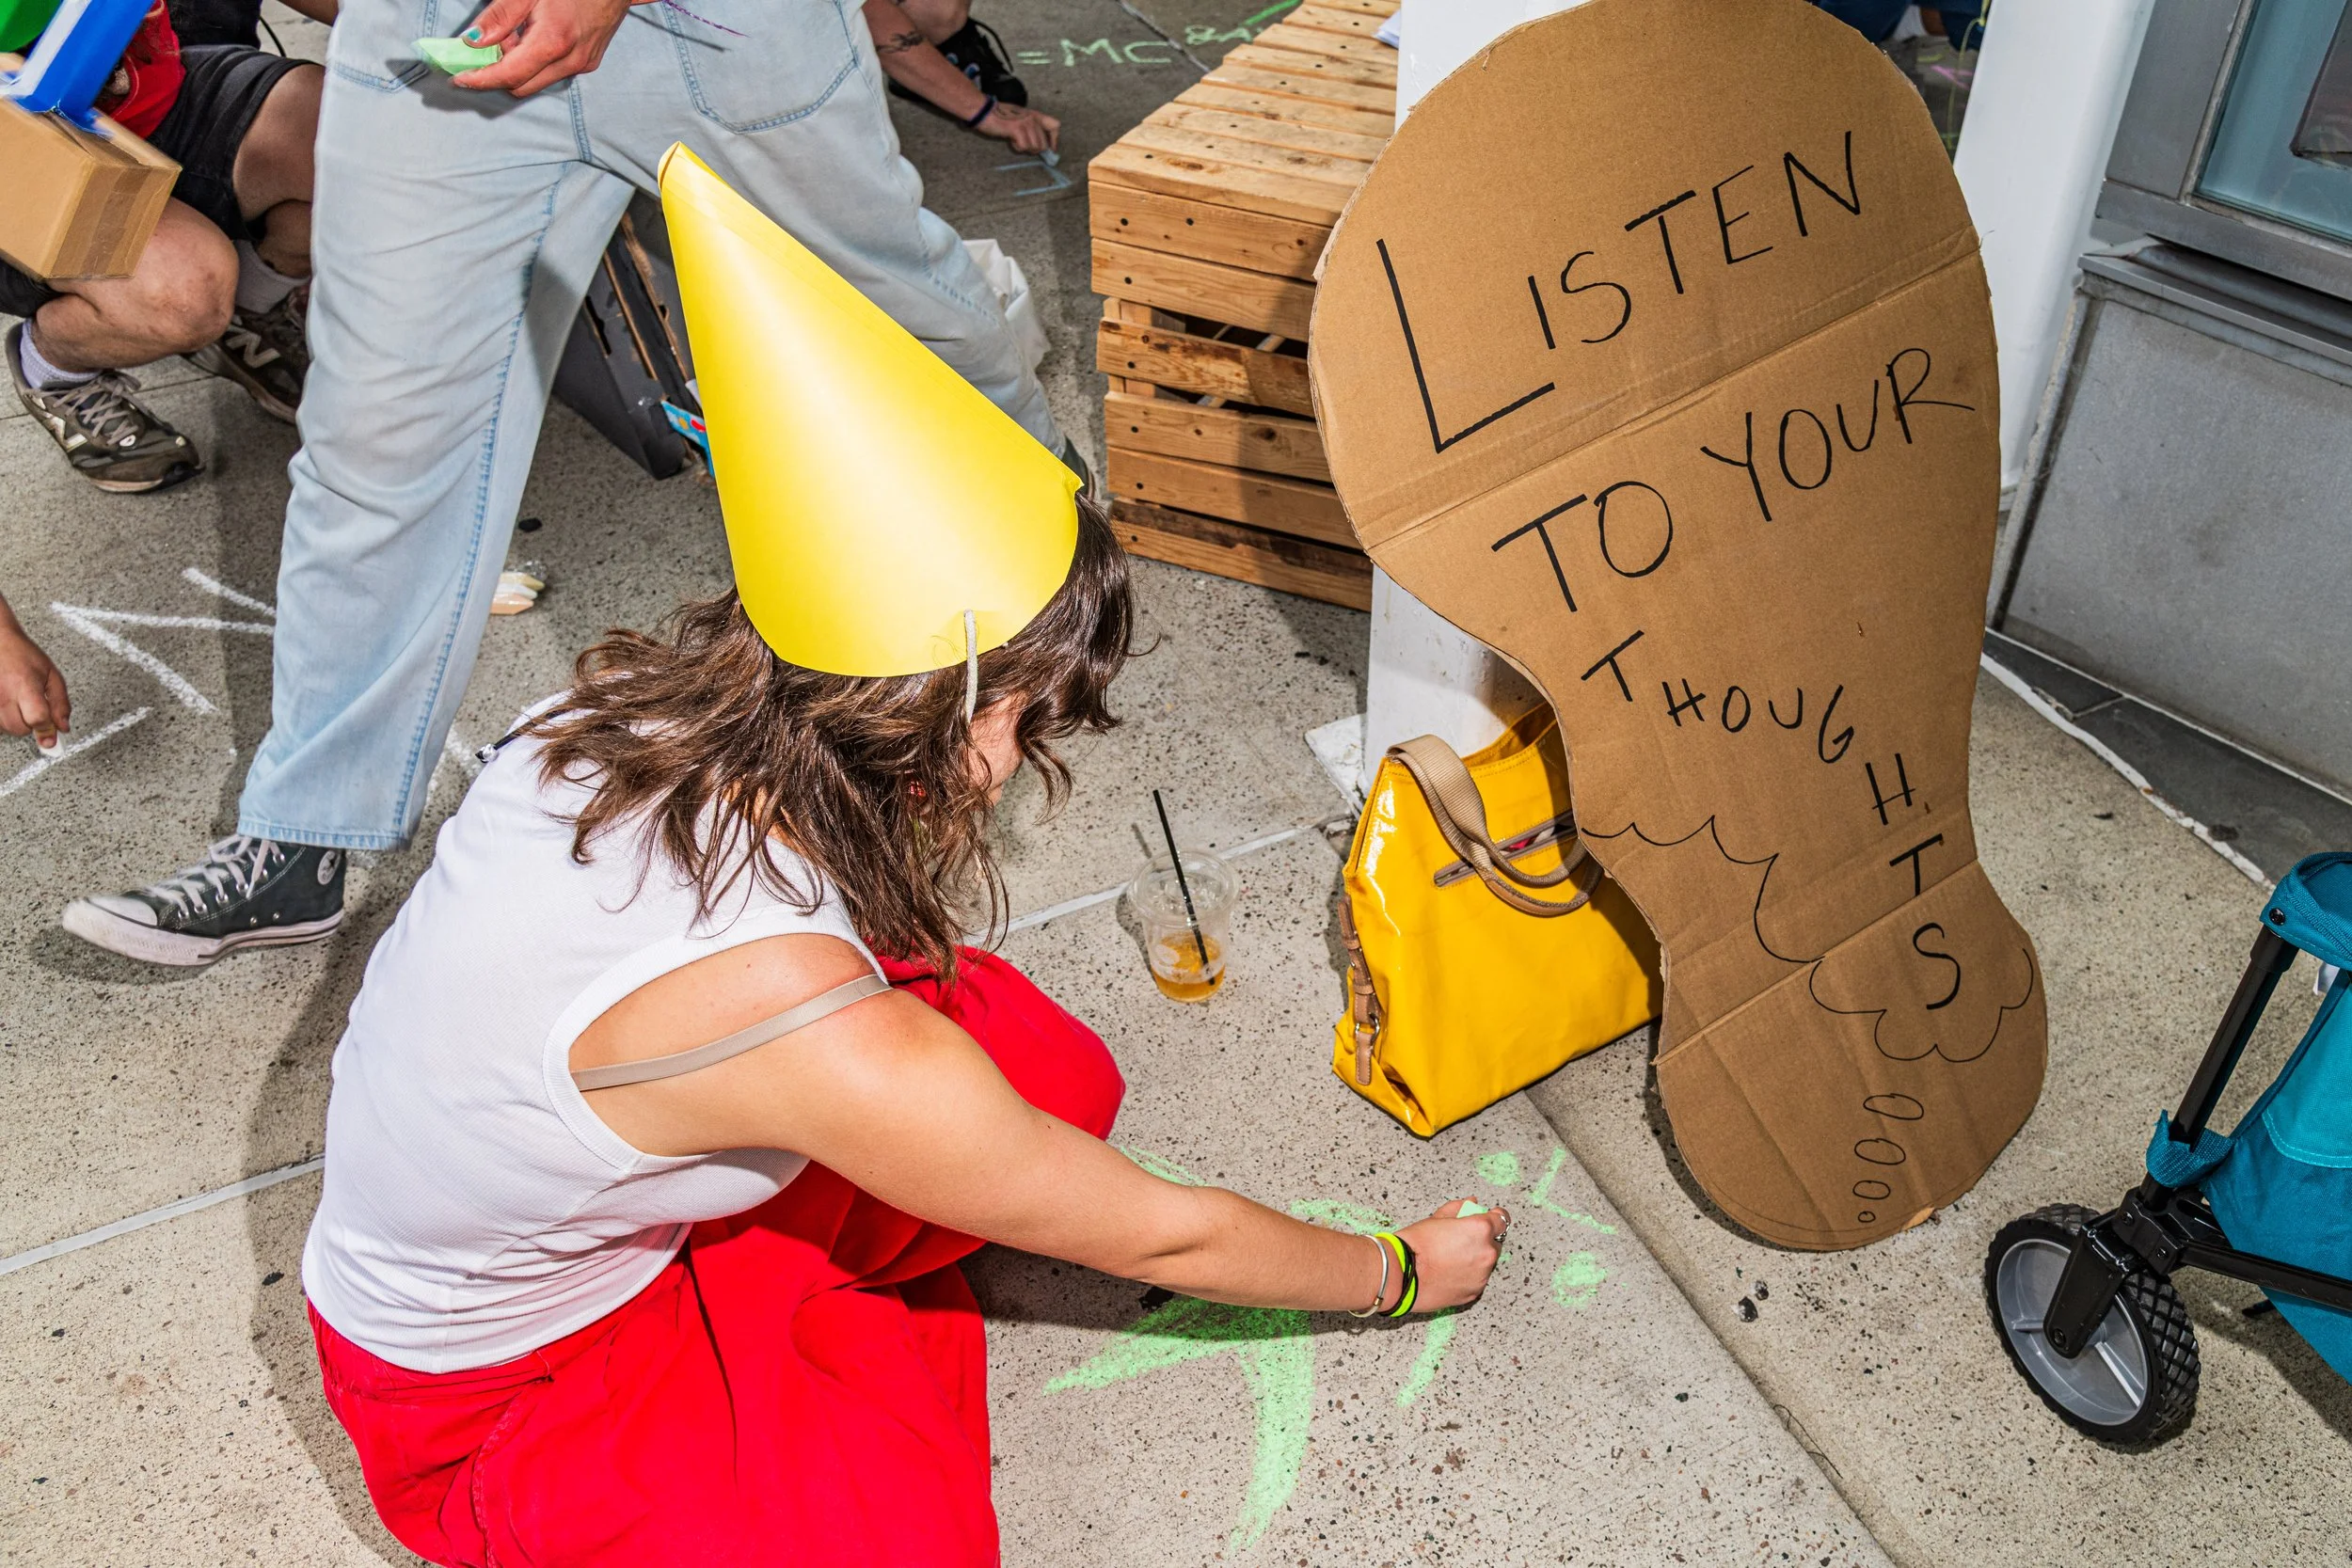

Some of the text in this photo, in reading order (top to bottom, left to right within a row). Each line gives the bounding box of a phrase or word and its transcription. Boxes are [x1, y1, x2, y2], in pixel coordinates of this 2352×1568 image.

[1376, 131, 1862, 454] LISTEN
[1491, 348, 1976, 611] TO YOUR
[1581, 630, 1963, 1011] THOUGHTS
